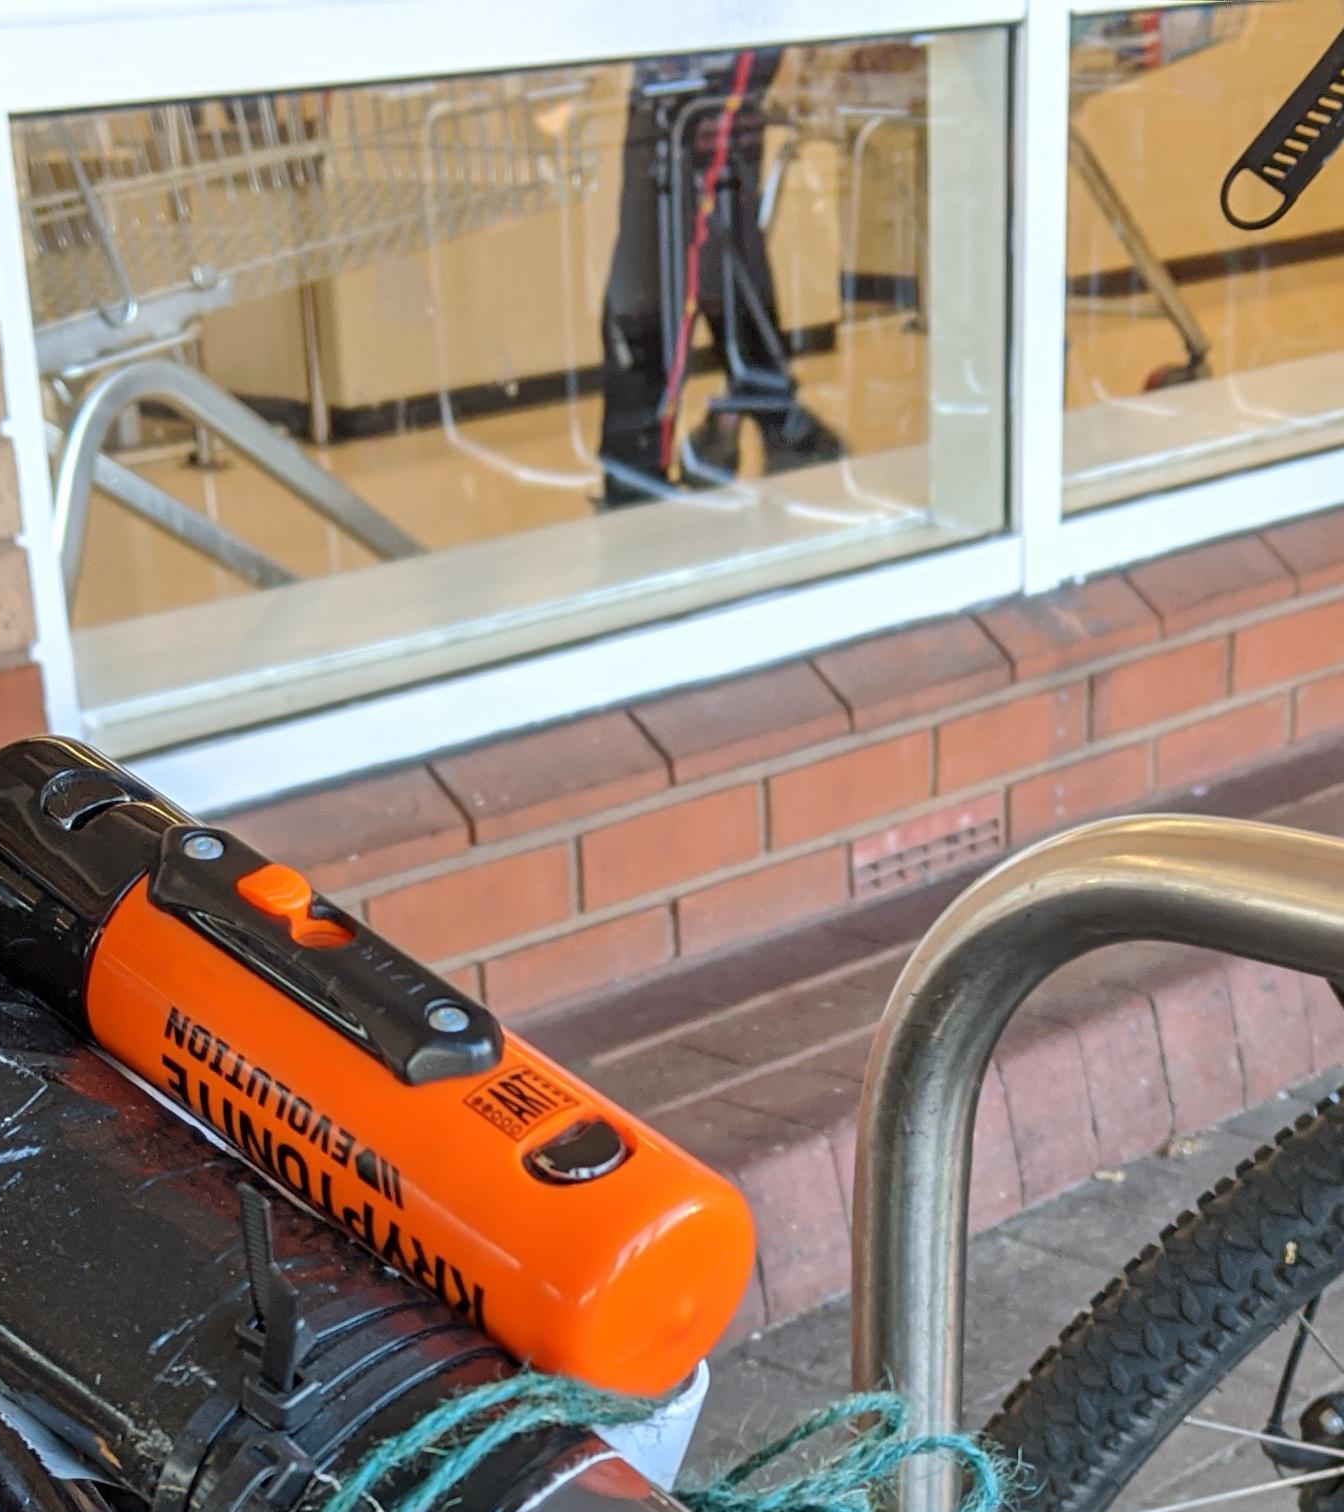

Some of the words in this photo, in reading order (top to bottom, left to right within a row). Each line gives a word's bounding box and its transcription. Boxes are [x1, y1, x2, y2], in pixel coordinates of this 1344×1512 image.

[164, 1007, 358, 1168] EVOLUTION
[486, 1072, 558, 1126] ART
[162, 1054, 492, 1332] KRYPTONITE
